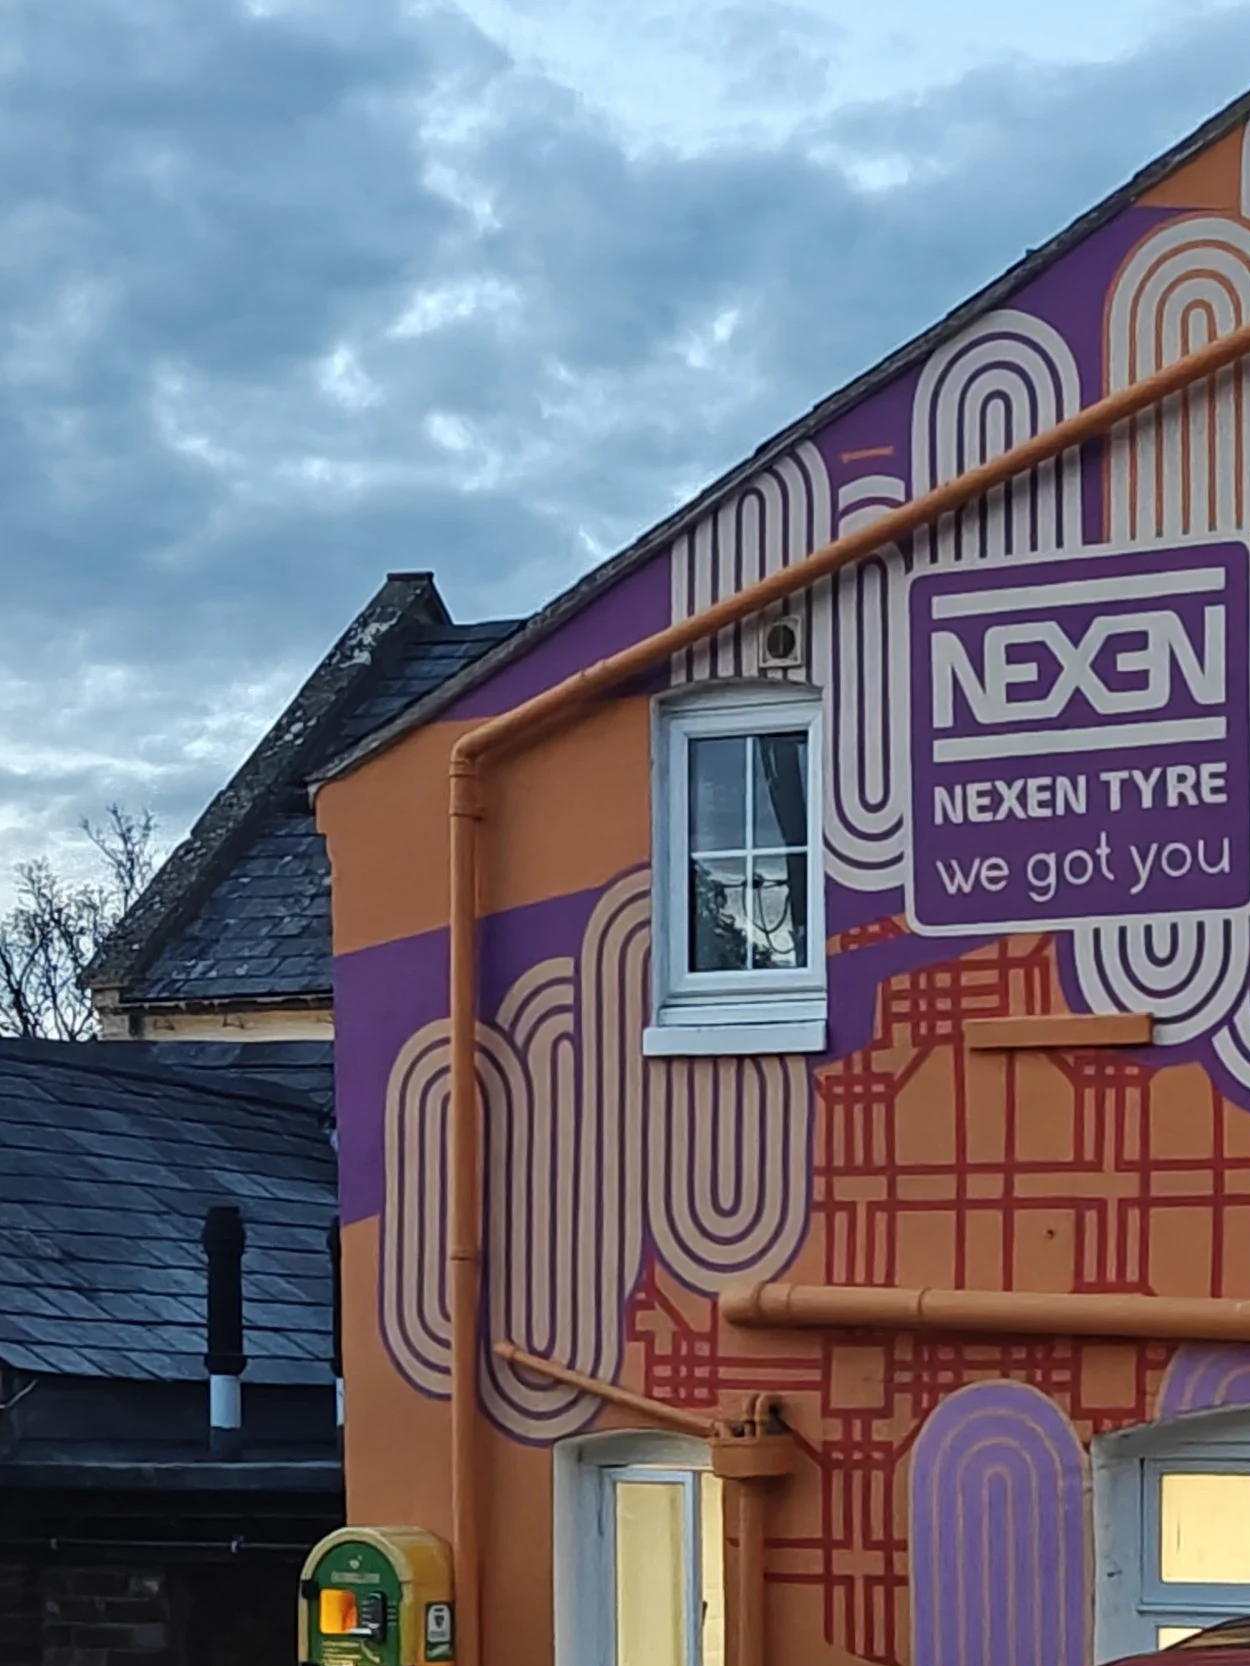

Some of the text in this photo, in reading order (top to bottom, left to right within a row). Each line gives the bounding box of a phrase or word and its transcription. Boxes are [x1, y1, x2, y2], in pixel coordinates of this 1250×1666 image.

[931, 604, 1227, 729] NEXEN
[934, 762, 1228, 826] NEXEN TYRE
[936, 831, 1231, 902] we got you
